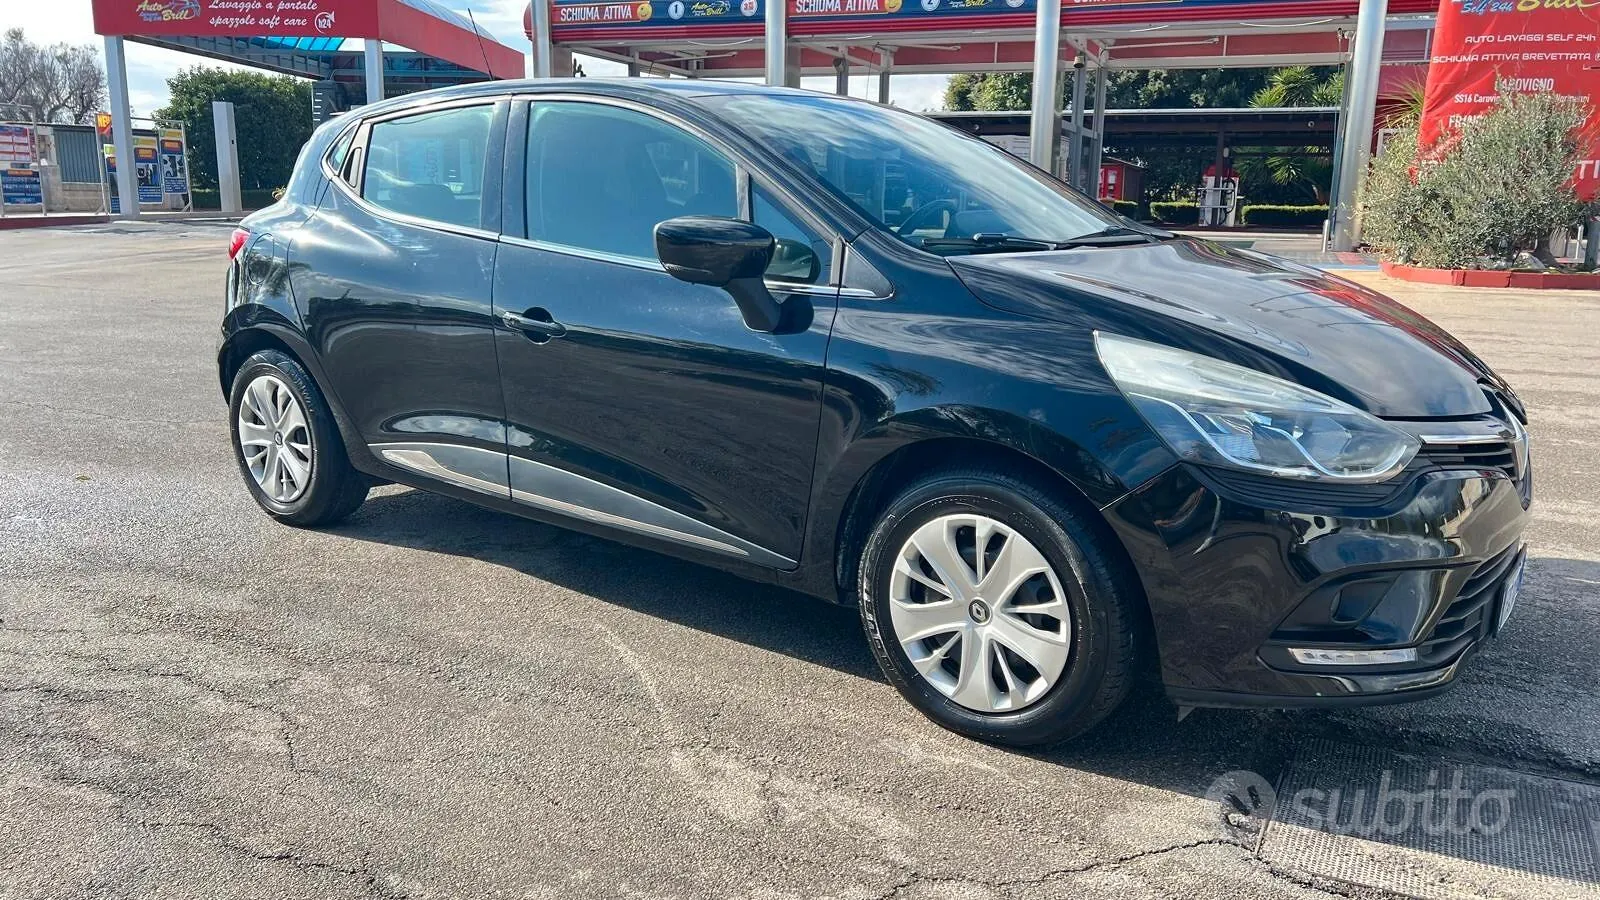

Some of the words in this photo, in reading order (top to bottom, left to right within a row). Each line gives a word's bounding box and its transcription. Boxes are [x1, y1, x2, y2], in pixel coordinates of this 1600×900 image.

[209, 0, 262, 12] Lavaggio
[277, 0, 318, 12] portale
[796, 0, 841, 13] SCHIUMA
[845, 0, 879, 11] ATTIVA
[560, 7, 600, 21] SCHIUMA
[603, 5, 632, 20] ATTIVA
[209, 15, 255, 28] spazzole
[259, 15, 280, 29] soft
[284, 18, 308, 26] care
[1465, 35, 1495, 44] AUTO
[1497, 34, 1544, 43] LAVAGGI
[1546, 33, 1574, 42] SELF
[1576, 33, 1596, 42] 24h
[1432, 54, 1479, 64] SCHIUMA
[1481, 53, 1520, 62] ATTIVA
[1522, 52, 1591, 61] BREVETTATA
[1454, 94, 1473, 104] SS16
